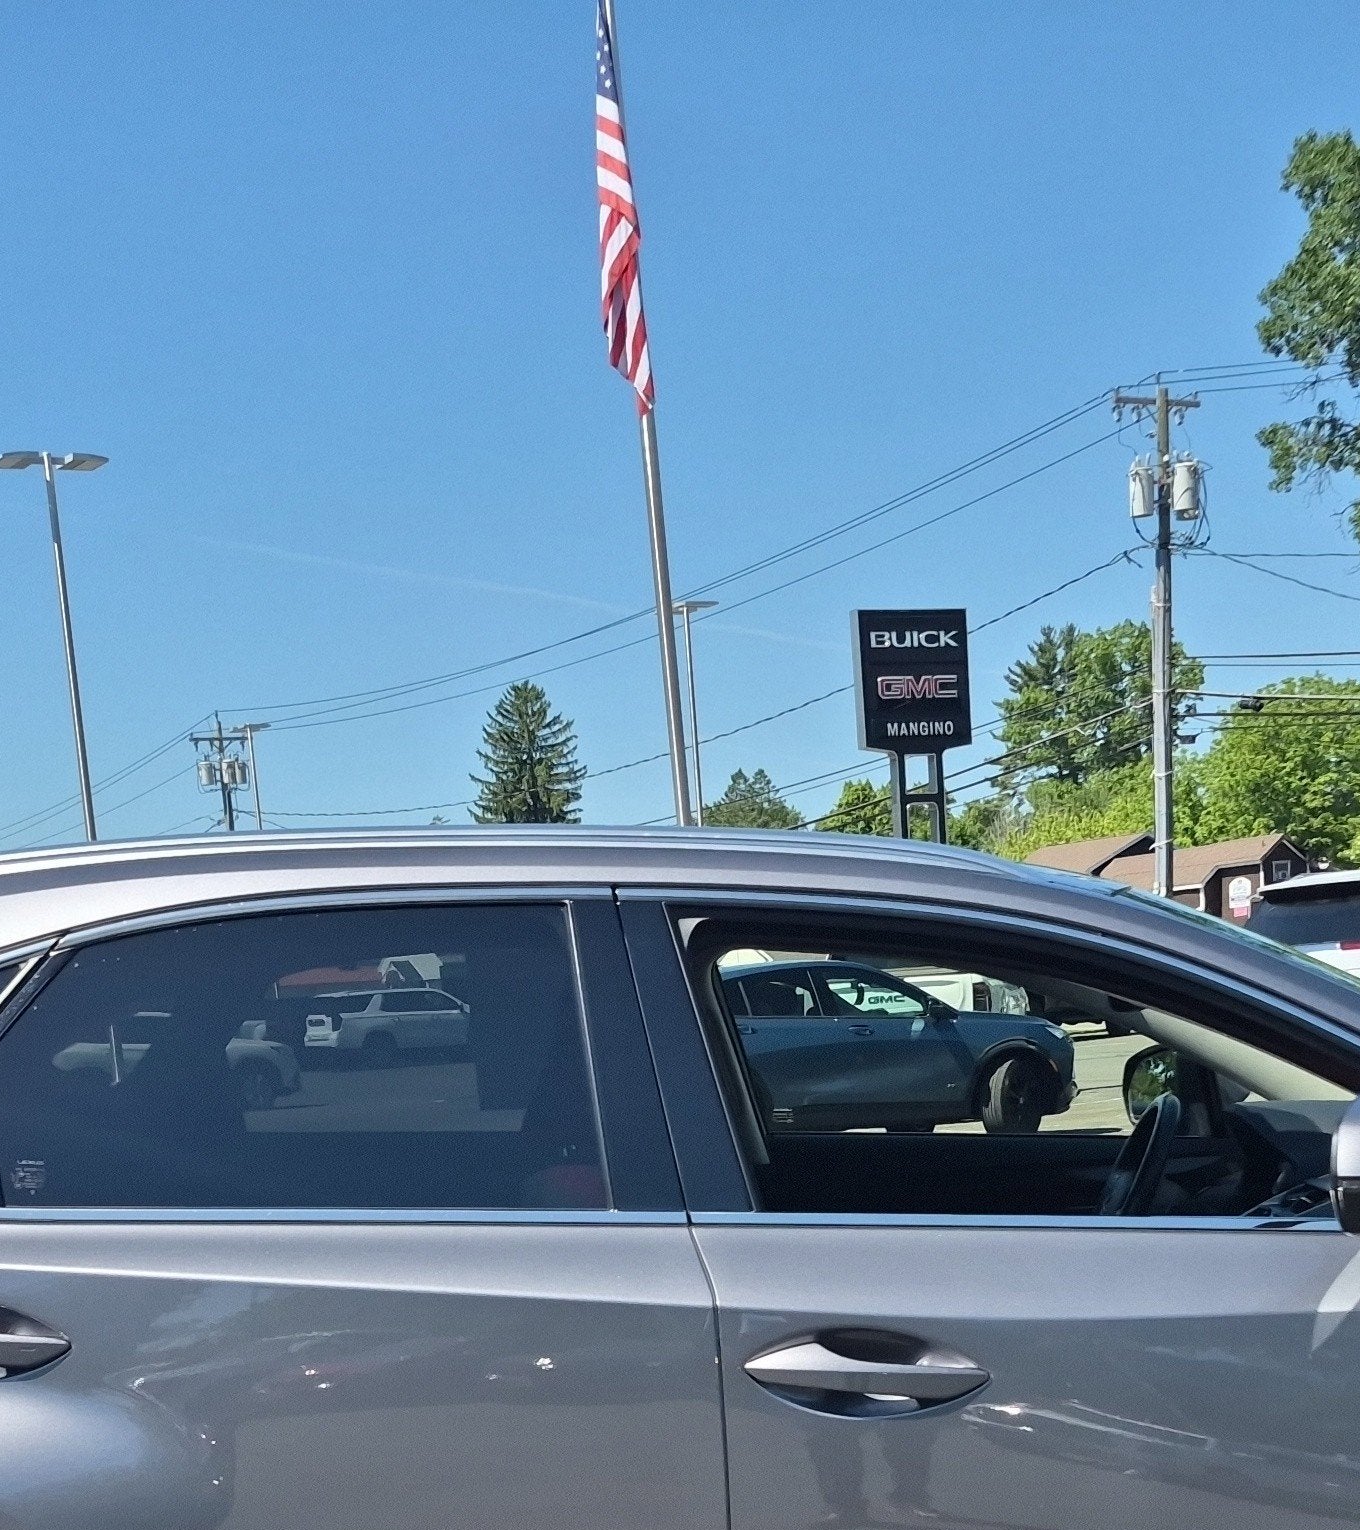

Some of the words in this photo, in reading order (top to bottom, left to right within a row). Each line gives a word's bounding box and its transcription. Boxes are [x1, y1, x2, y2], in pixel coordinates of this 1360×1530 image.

[869, 630, 959, 648] BUICK
[877, 674, 958, 700] GMC
[886, 720, 954, 737] MANGINO
[867, 994, 906, 1005] GMC
